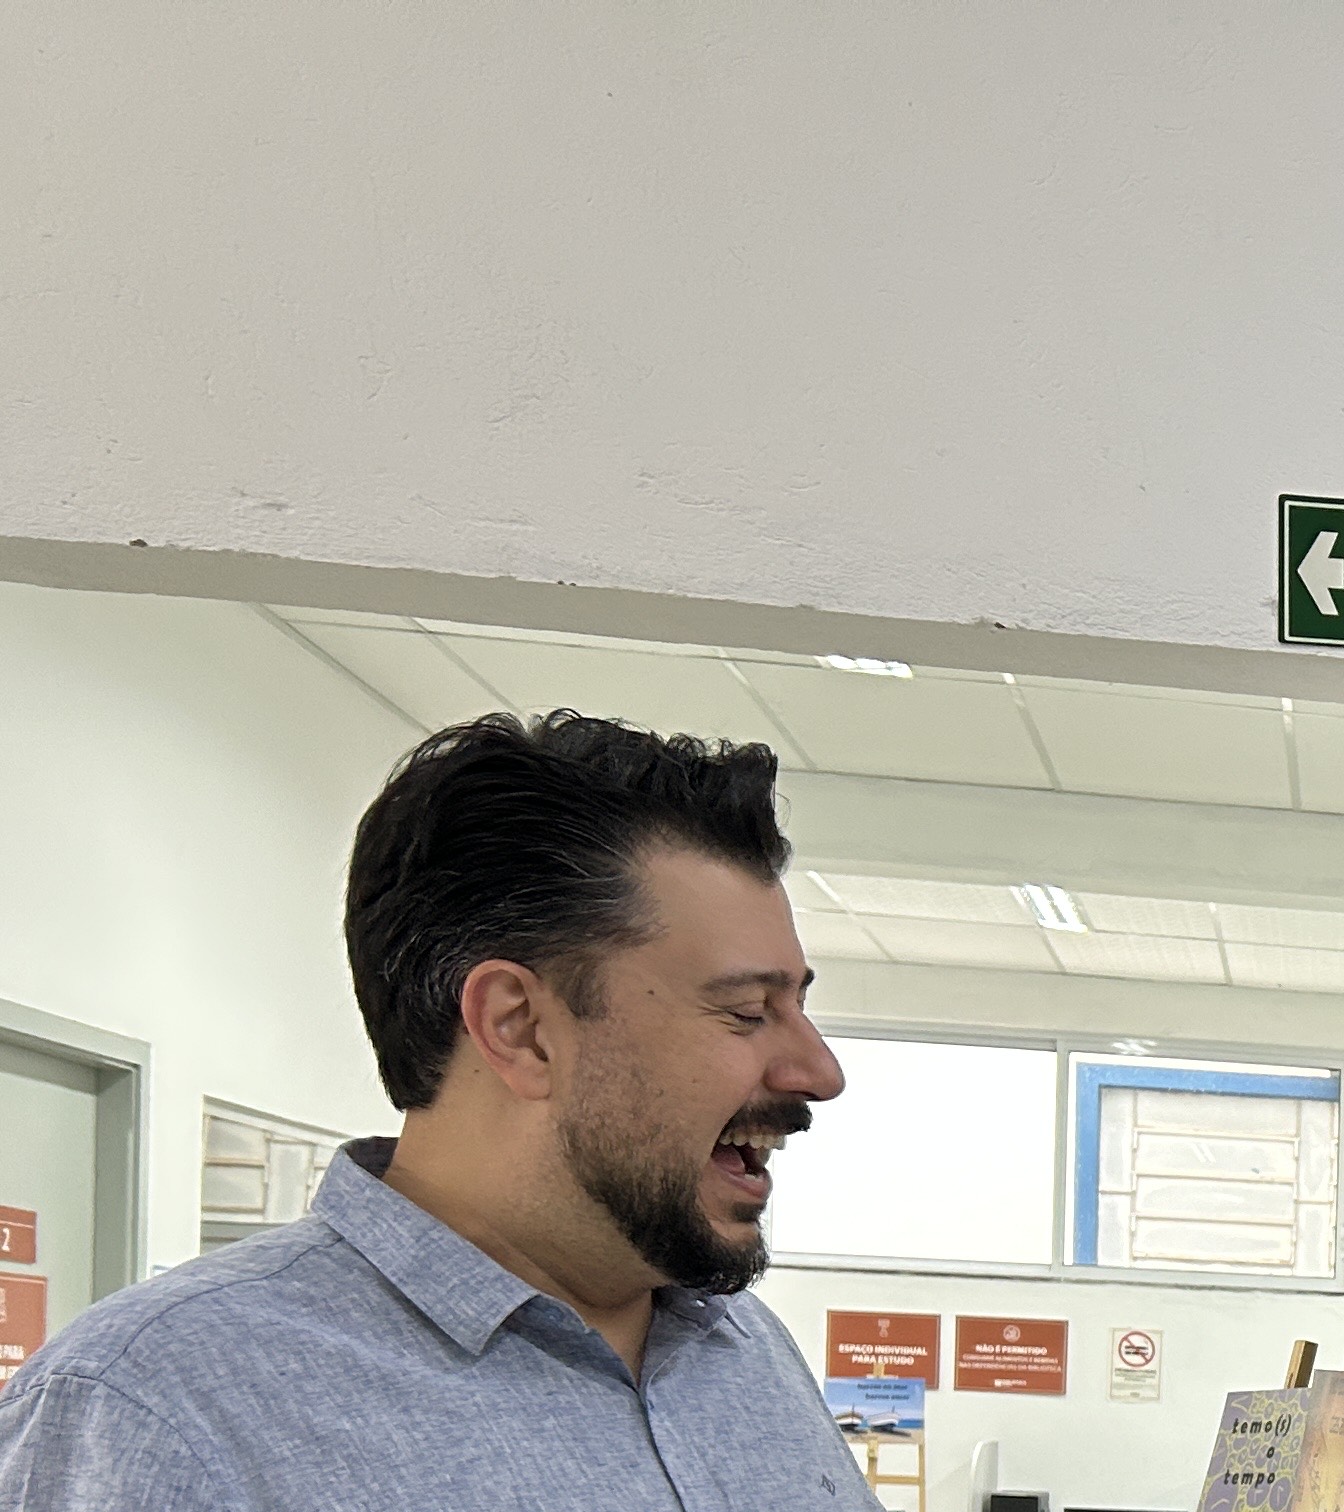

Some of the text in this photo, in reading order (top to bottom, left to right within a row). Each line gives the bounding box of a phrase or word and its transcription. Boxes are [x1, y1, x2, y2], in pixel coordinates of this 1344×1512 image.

[839, 1342, 927, 1356] ESPAÇO INDIVIDUAL
[852, 1354, 914, 1365] PARA ESTUDO
[1224, 1469, 1275, 1488] tempo
